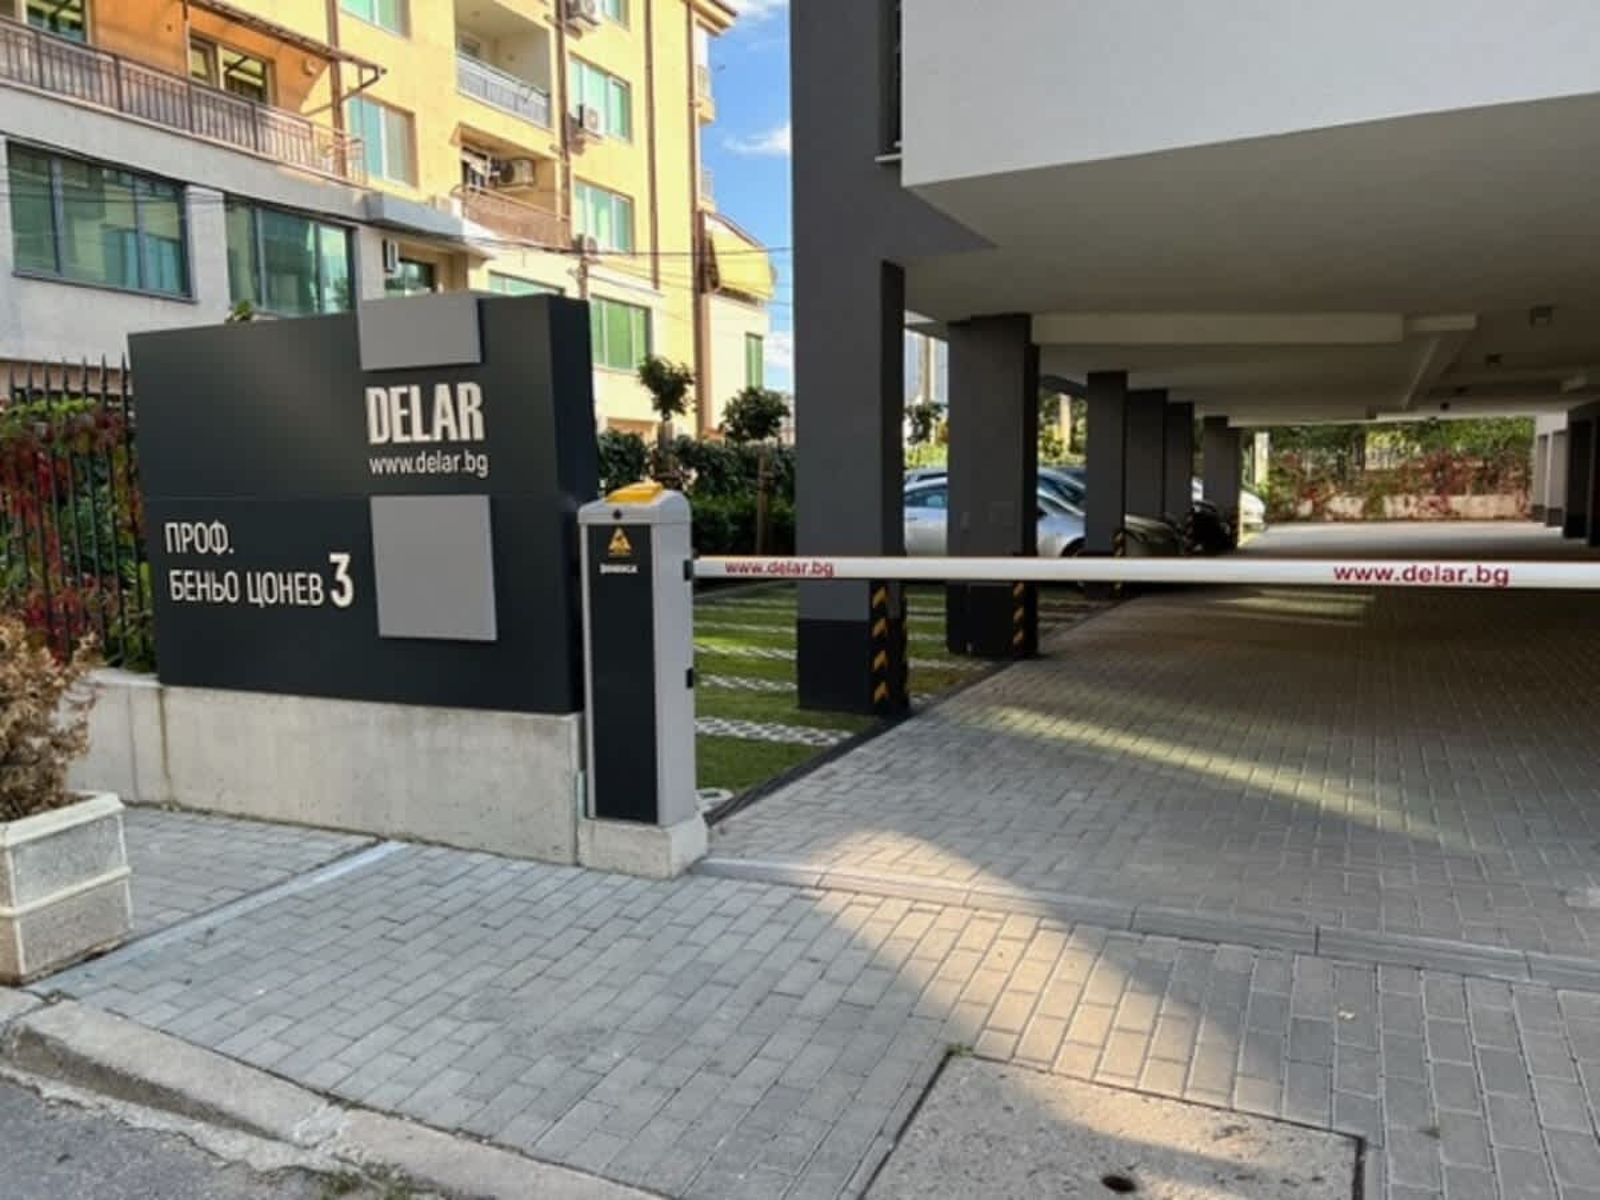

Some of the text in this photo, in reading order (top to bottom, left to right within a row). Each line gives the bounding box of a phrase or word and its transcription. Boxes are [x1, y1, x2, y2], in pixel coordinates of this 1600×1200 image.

[365, 382, 485, 444] DELAR
[368, 451, 489, 478] www.delar.bg
[164, 519, 234, 555] ПРОФ.
[169, 552, 354, 608] БЕНЬО ЦОНЕВ 3
[724, 560, 834, 578] www.delar.bg
[1333, 564, 1510, 587] www.delar.bg
